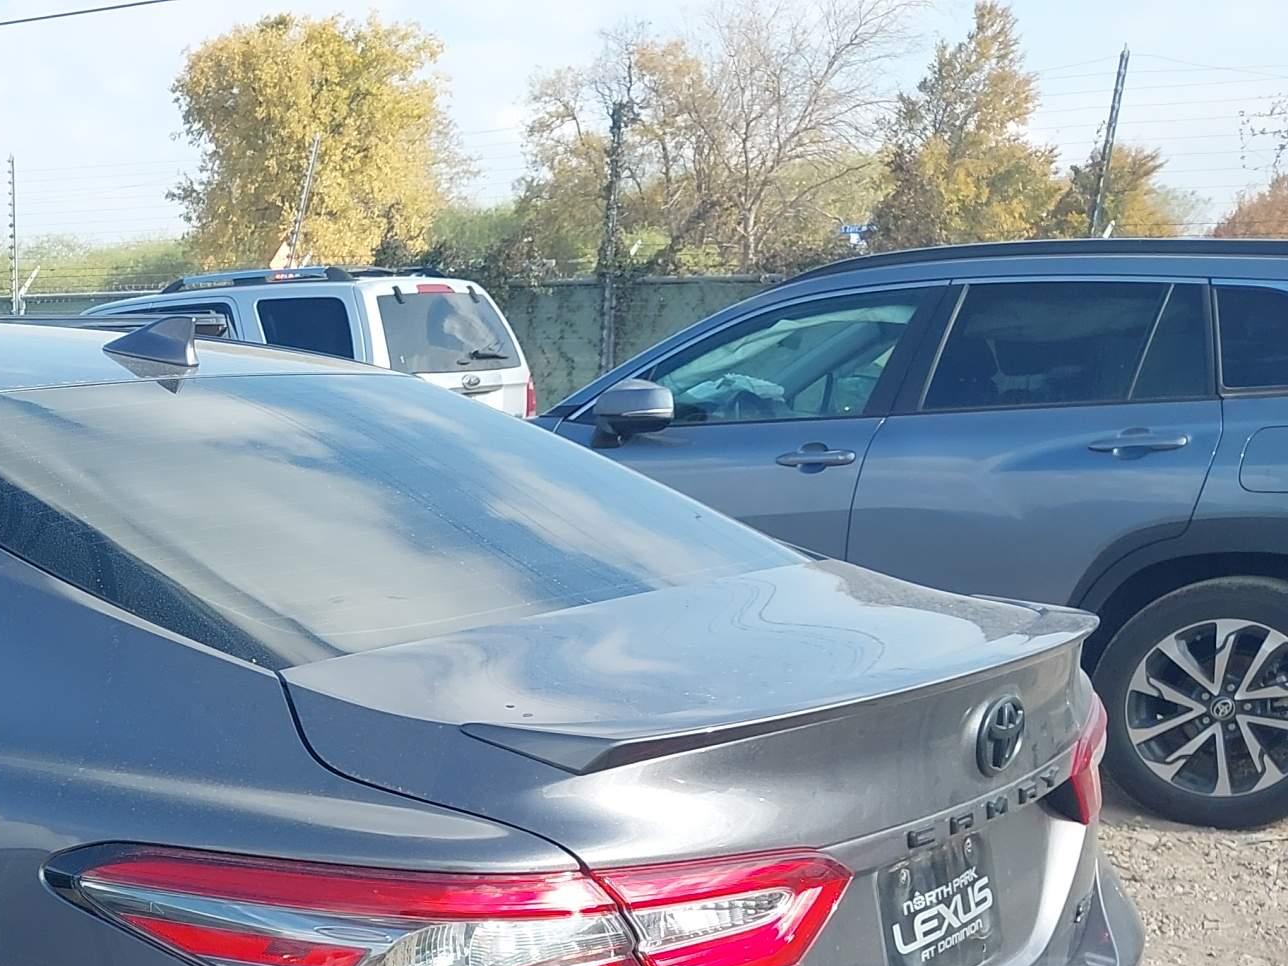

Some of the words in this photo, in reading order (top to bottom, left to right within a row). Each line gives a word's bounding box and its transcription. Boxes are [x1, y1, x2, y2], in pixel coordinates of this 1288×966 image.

[892, 876, 993, 955] LEXUS
[903, 882, 952, 916] NORTH
[952, 866, 979, 892] PARK
[921, 945, 936, 962] AT
[937, 918, 984, 954] DOMINION
